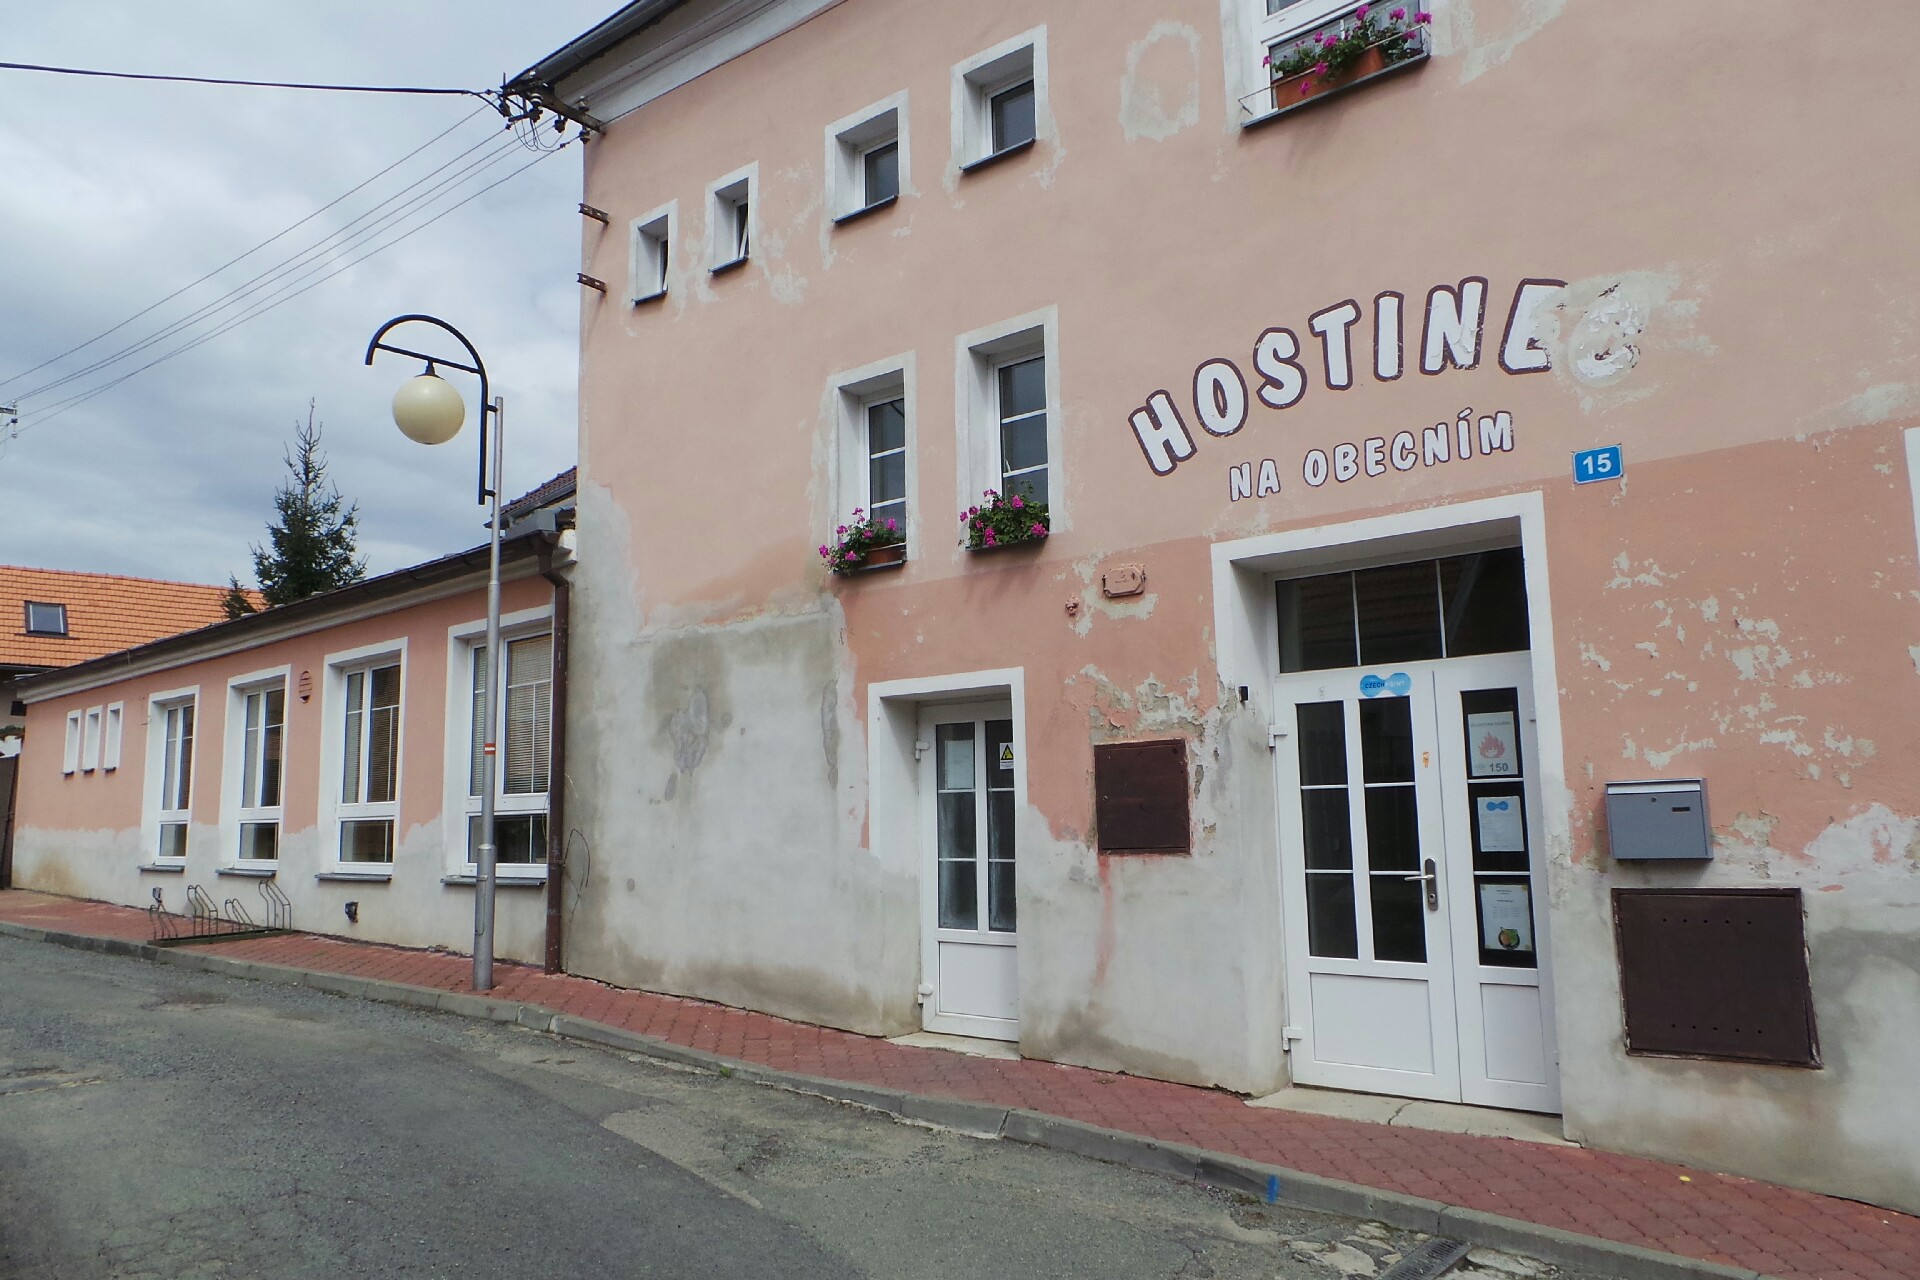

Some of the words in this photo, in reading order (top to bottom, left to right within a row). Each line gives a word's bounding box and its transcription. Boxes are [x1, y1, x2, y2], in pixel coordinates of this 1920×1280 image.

[1229, 458, 1281, 502] NA
[1303, 407, 1516, 487] OBECNÍM
[1582, 453, 1612, 475] 15
[1489, 762, 1509, 773] 150
